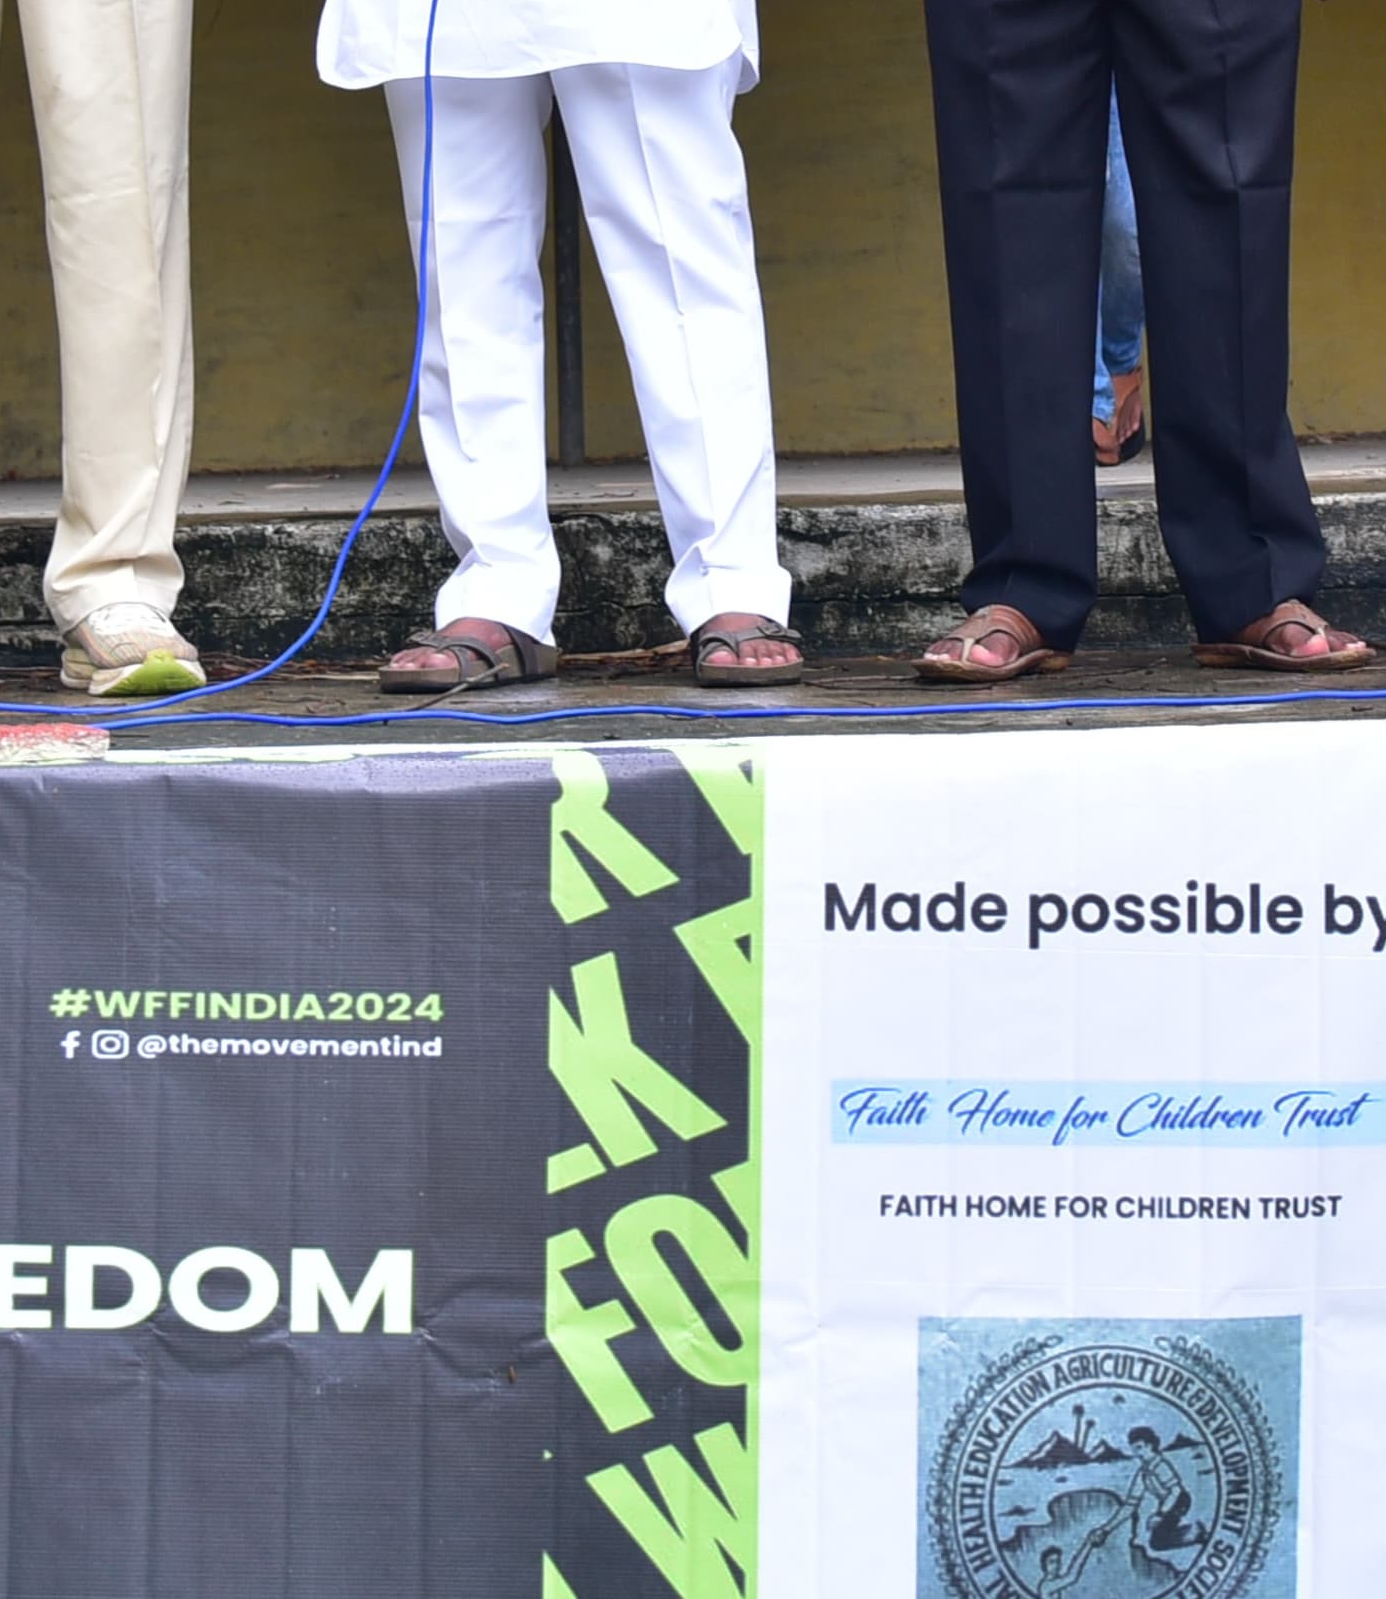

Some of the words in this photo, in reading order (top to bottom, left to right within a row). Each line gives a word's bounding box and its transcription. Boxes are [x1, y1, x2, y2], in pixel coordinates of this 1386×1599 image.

[824, 881, 1008, 933] Made
[1028, 880, 1303, 950] possible
[48, 987, 445, 1022] #WFFINDIA2024
[136, 1032, 443, 1060] @themovementind
[839, 1086, 929, 1137] Faith
[947, 1087, 1056, 1136] Home
[1051, 1095, 1109, 1146] for
[1116, 1091, 1265, 1138] Children
[1273, 1089, 1382, 1138] Trust
[879, 1194, 958, 1218] FAITH
[965, 1194, 1047, 1219] HOME
[1054, 1195, 1109, 1219] FOR
[1114, 1195, 1251, 1220] CHILDREN
[1258, 1194, 1343, 1220] TRUST
[1052, 1351, 1196, 1401] AGRICULTURE
[964, 1369, 1052, 1479] EDUCATION
[1195, 1393, 1251, 1538] DEVELOPMENT
[959, 1482, 997, 1574] HEALTH
